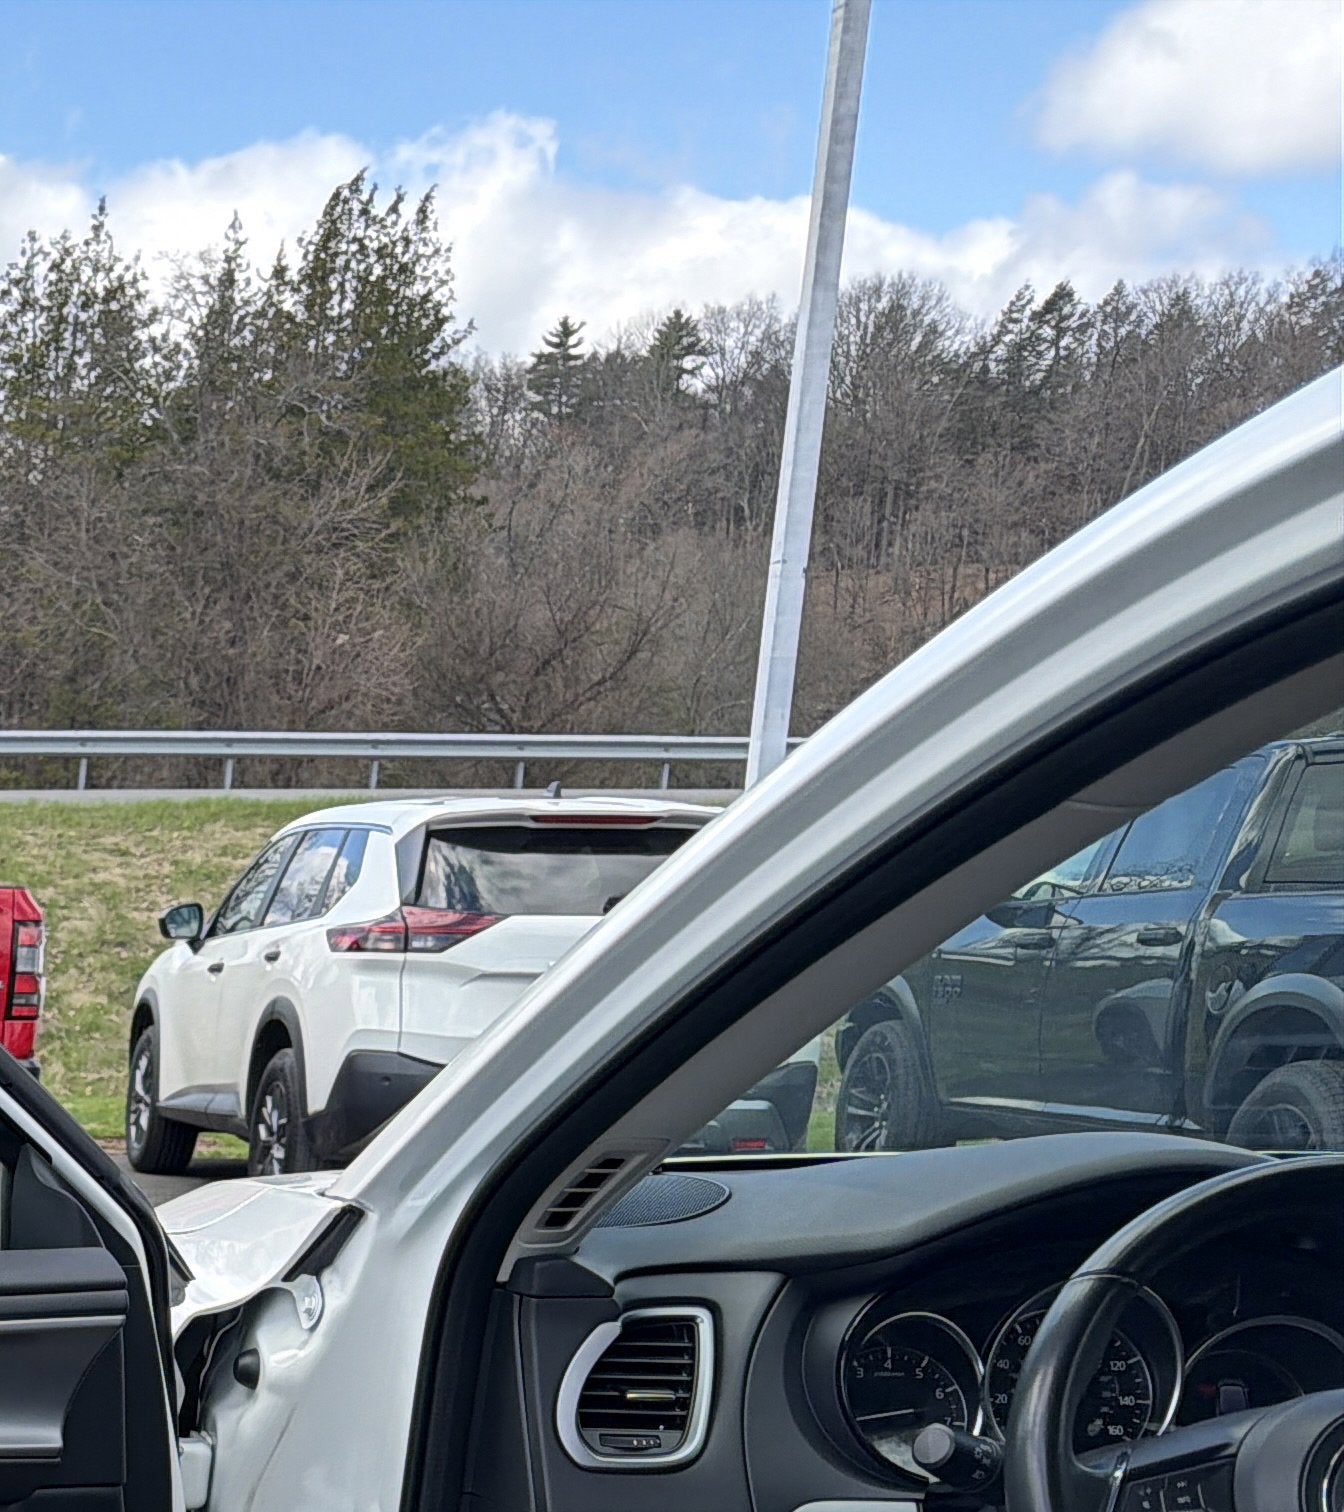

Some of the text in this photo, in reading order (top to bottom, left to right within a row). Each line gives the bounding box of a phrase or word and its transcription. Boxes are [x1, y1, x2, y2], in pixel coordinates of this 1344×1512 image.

[1017, 1335, 1032, 1347] 60
[883, 1358, 892, 1370] 4
[996, 1359, 1010, 1369] 40
[1110, 1360, 1127, 1371] 120
[855, 1367, 865, 1379] 3
[915, 1367, 925, 1379] 5
[935, 1387, 945, 1399] 6
[994, 1393, 1008, 1404] 20
[1118, 1395, 1136, 1406] 140
[944, 1416, 952, 1426] 7
[1107, 1425, 1125, 1436] 160
